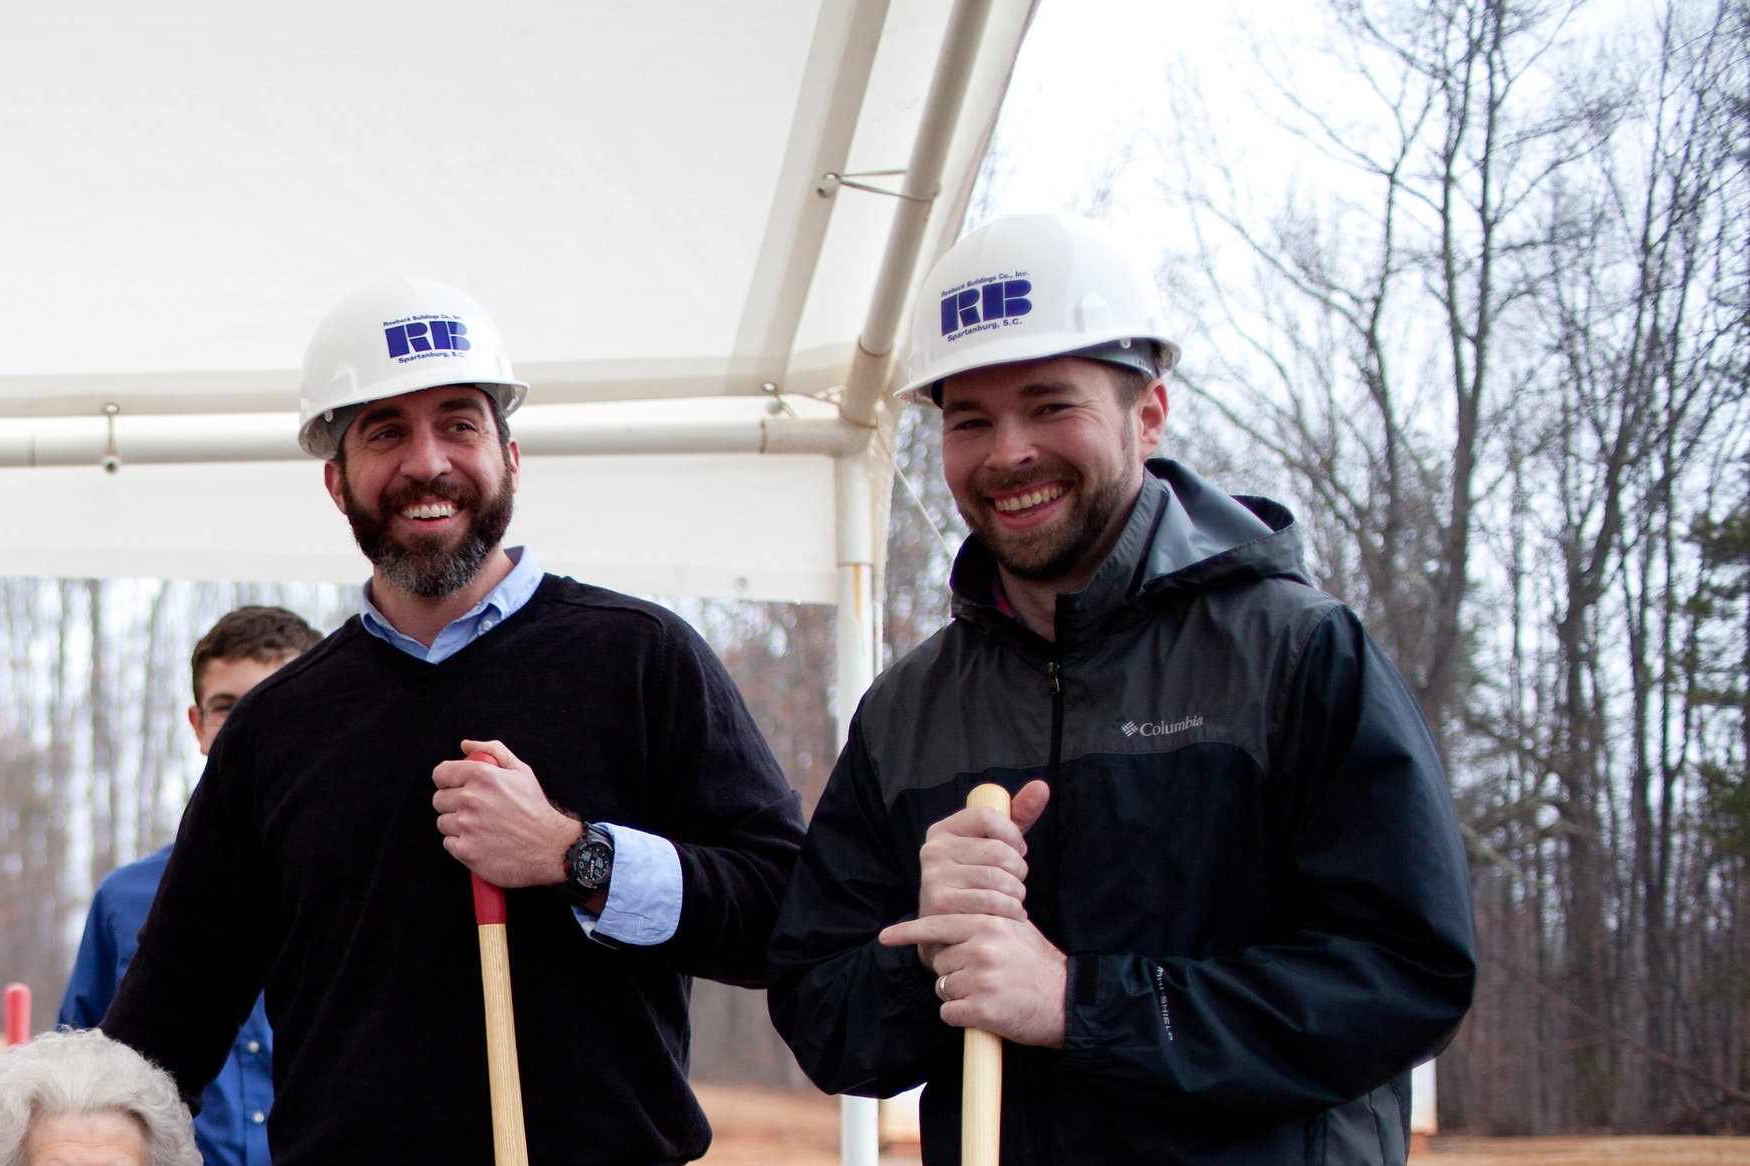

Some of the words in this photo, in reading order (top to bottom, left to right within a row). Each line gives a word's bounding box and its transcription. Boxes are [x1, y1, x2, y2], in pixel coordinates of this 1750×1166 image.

[941, 283, 965, 297] Roebuck
[967, 276, 996, 288] Buildings
[941, 279, 1032, 336] RB
[384, 321, 471, 358] RB
[947, 321, 1000, 342] Spartanburg,
[1003, 319, 1022, 327] S.C.
[398, 353, 450, 363] Spartanburg,
[1140, 715, 1203, 736] Columbia
